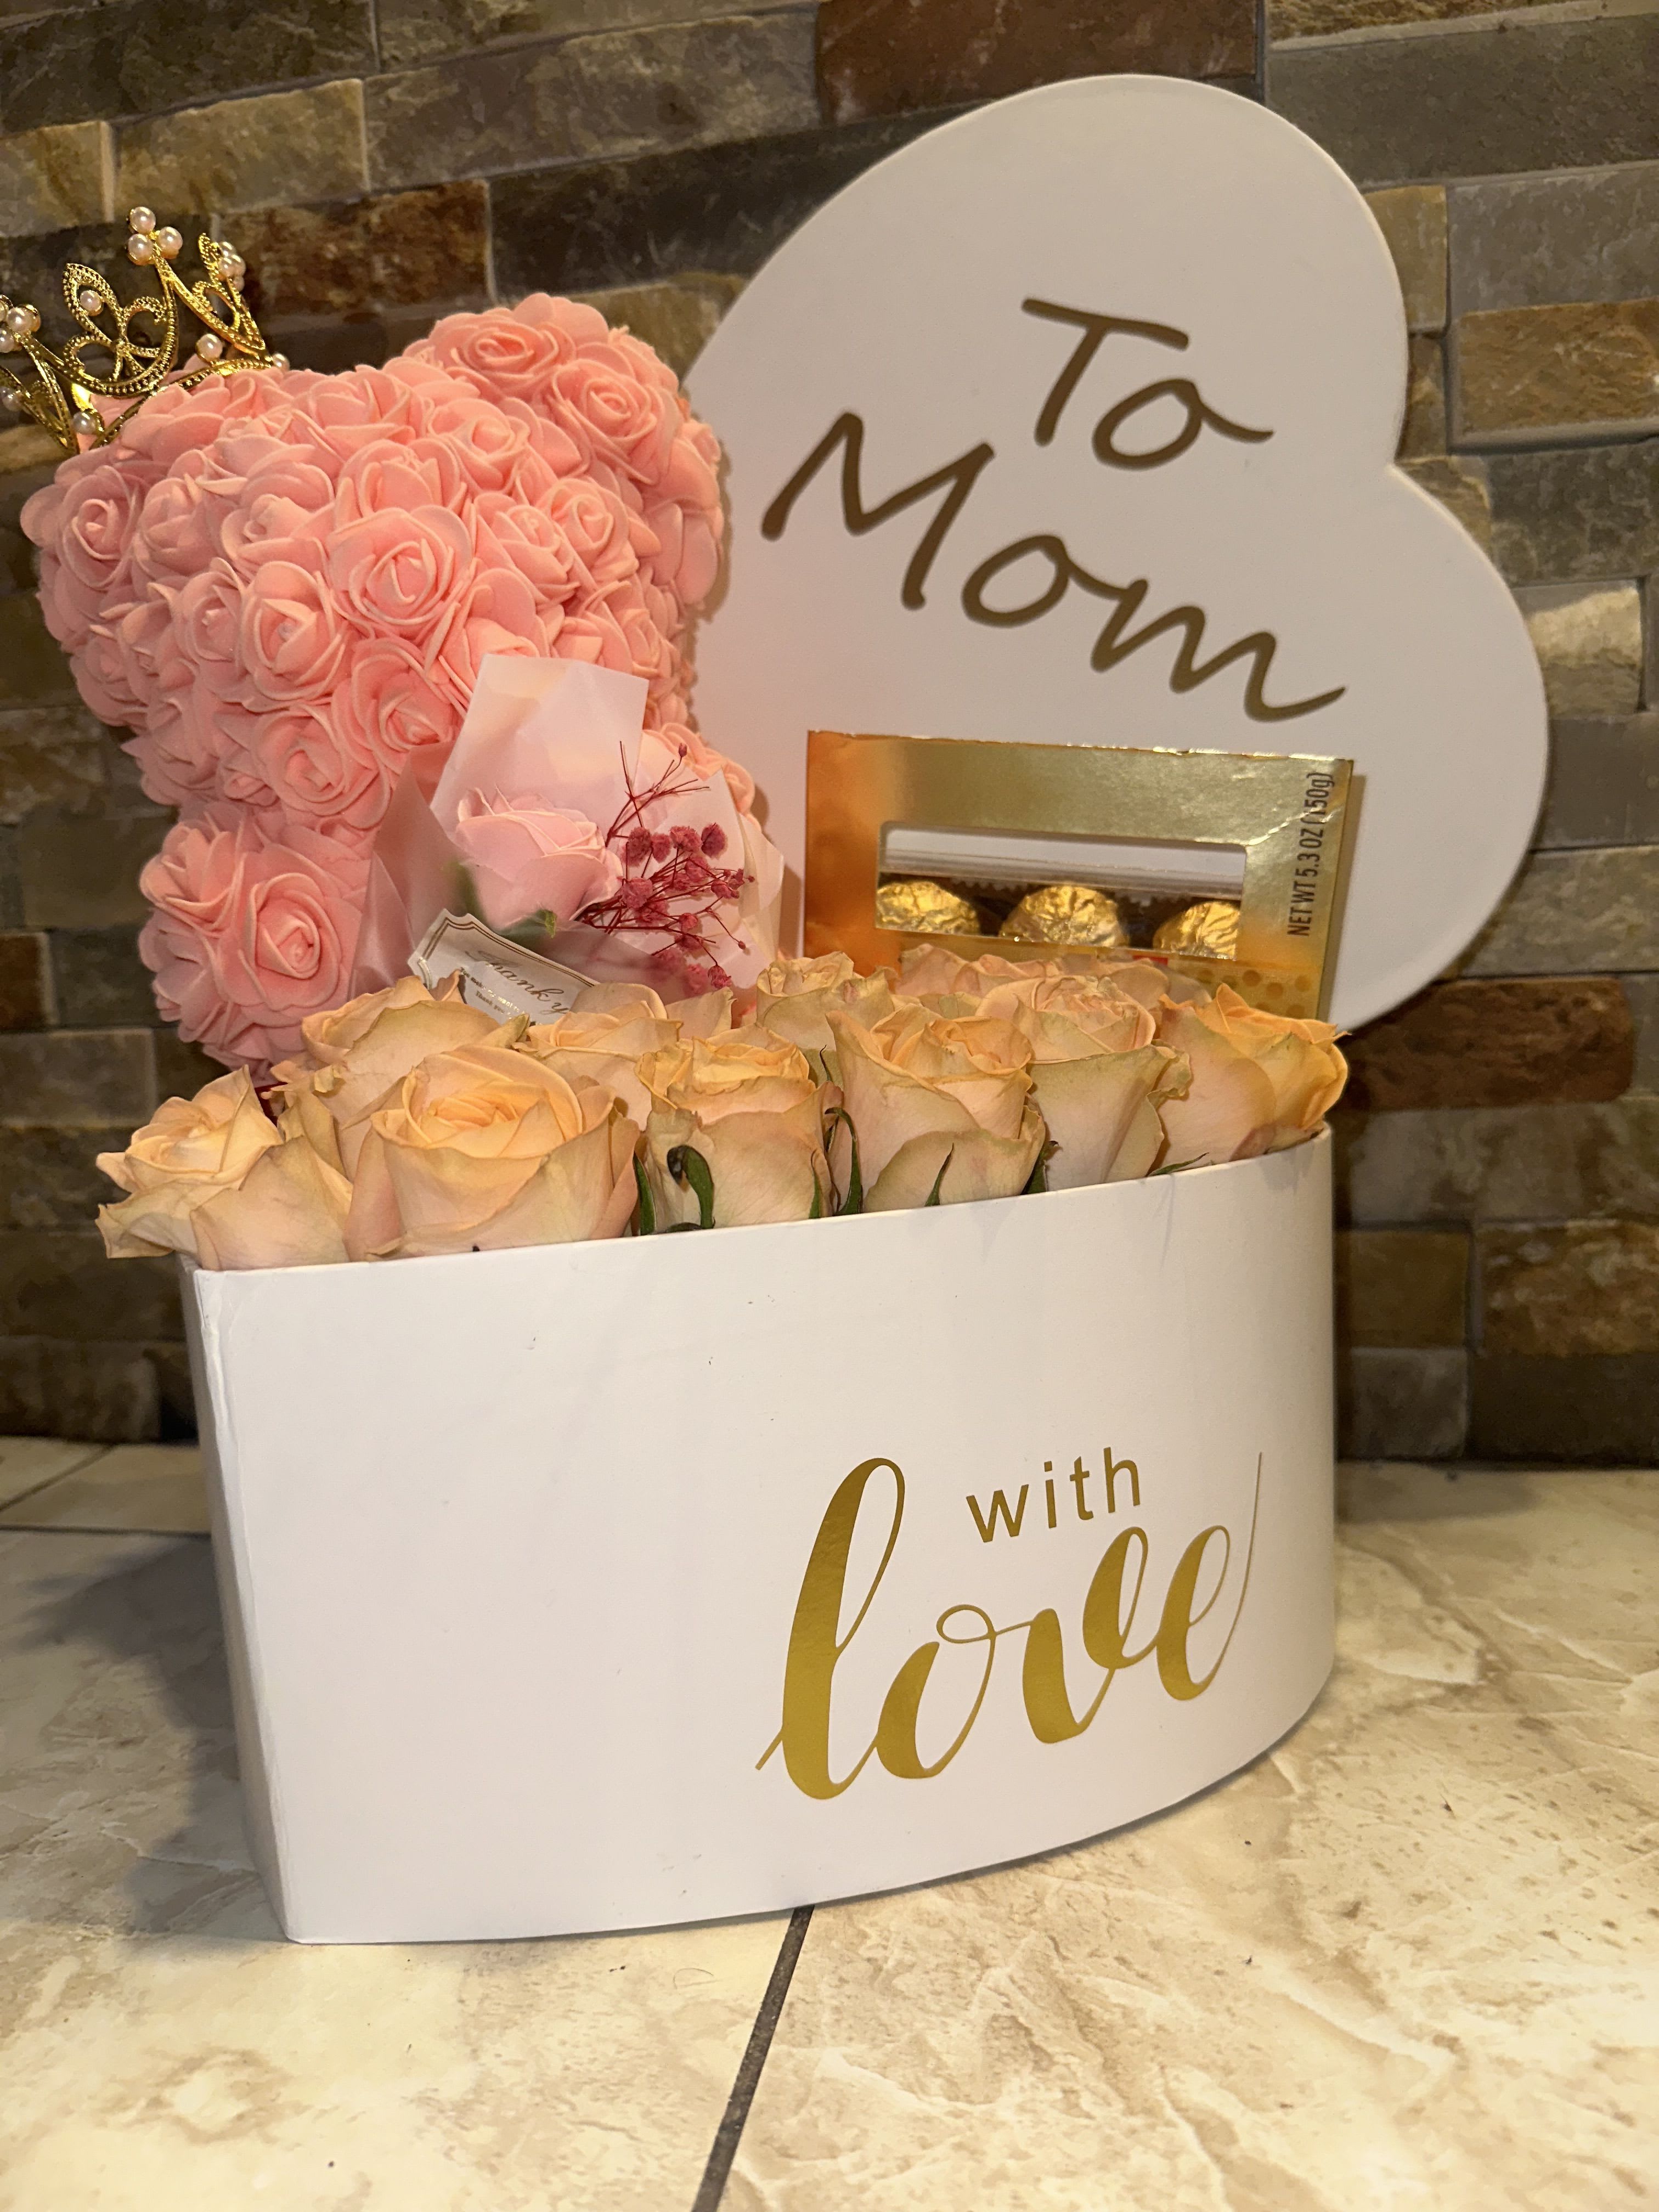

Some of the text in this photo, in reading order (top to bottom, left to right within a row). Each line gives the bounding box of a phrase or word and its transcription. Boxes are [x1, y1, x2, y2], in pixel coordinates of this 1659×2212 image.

[1022, 298, 1274, 470] To
[761, 410, 1346, 723] Mom
[1287, 772, 1335, 936] NET WT 5.3 OZ (150g)
[966, 1447, 1141, 1543] with
[755, 1452, 1262, 1800] love
